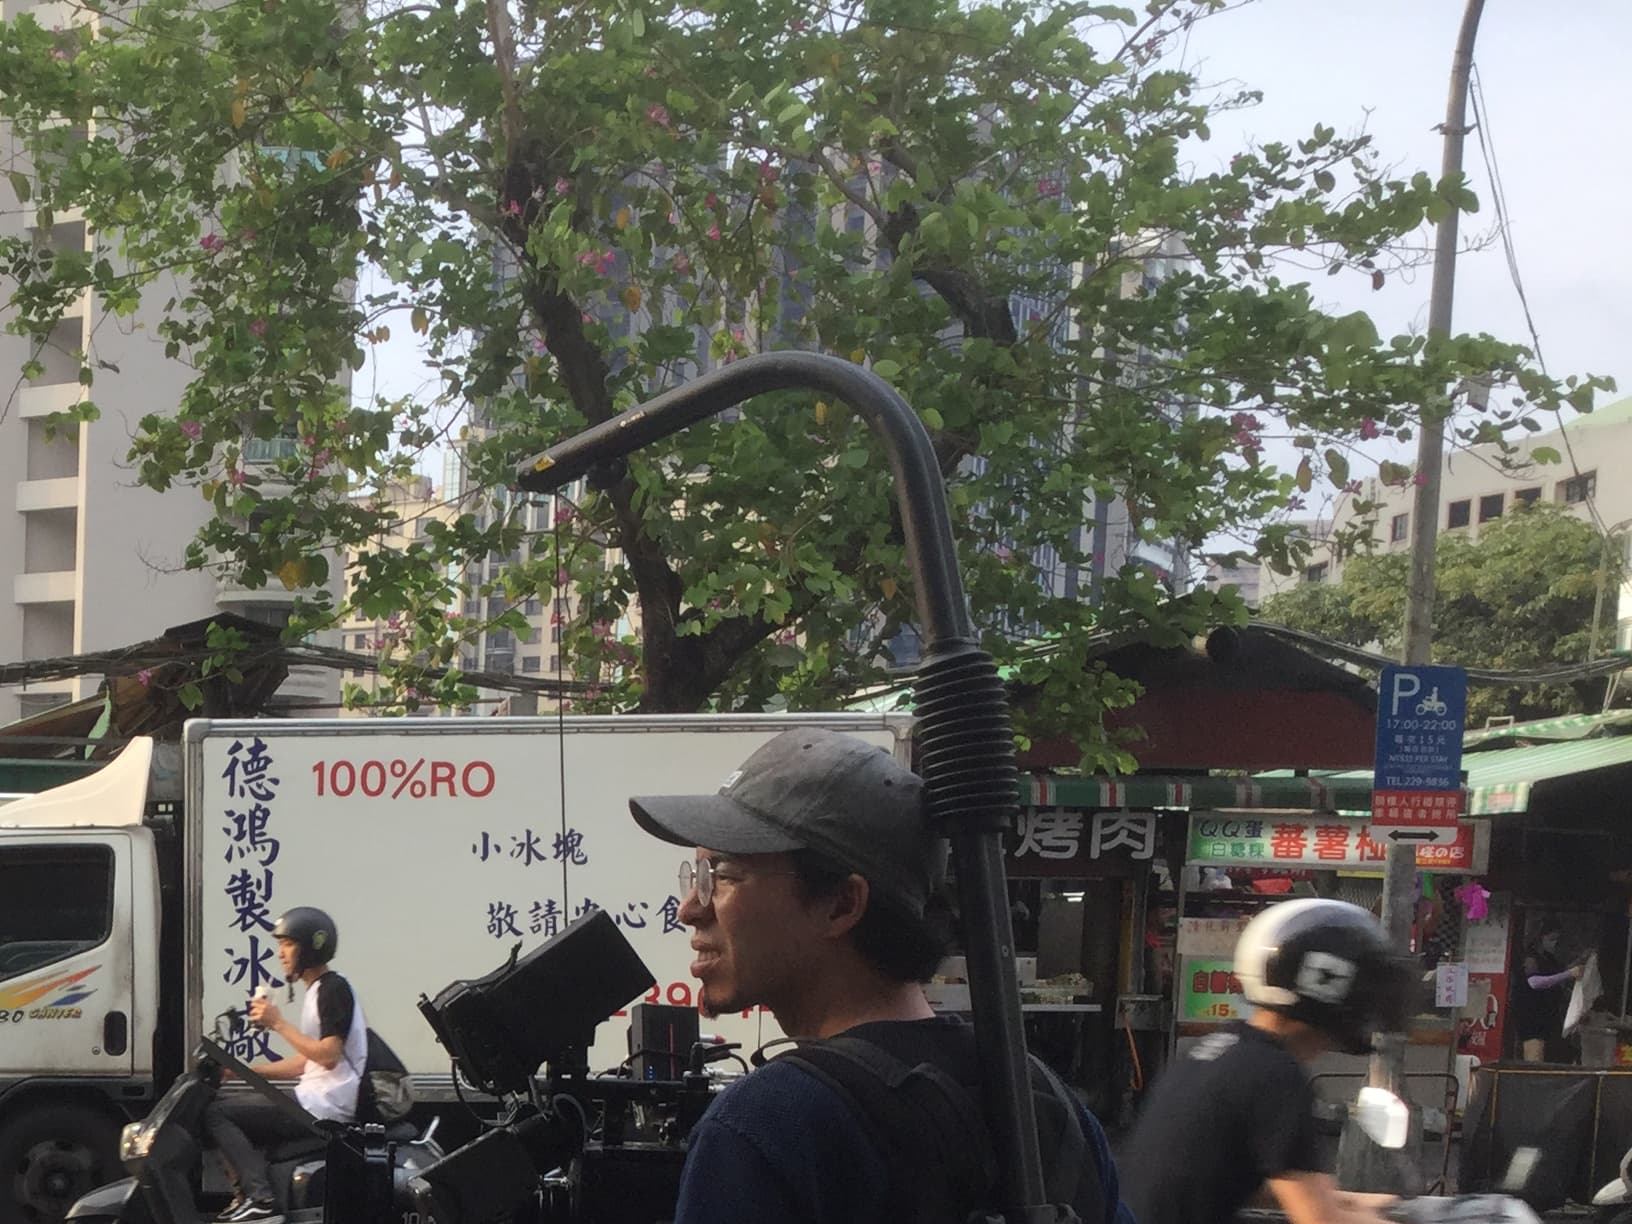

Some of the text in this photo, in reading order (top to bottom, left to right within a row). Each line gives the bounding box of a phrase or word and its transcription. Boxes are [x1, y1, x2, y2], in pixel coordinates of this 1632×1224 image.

[1392, 673, 1420, 715] P
[1386, 719, 1457, 731] 17:00-22:00
[312, 758, 496, 800] 100%RO
[472, 829, 588, 866] 小冰塊
[1002, 808, 1156, 859] 烤肉
